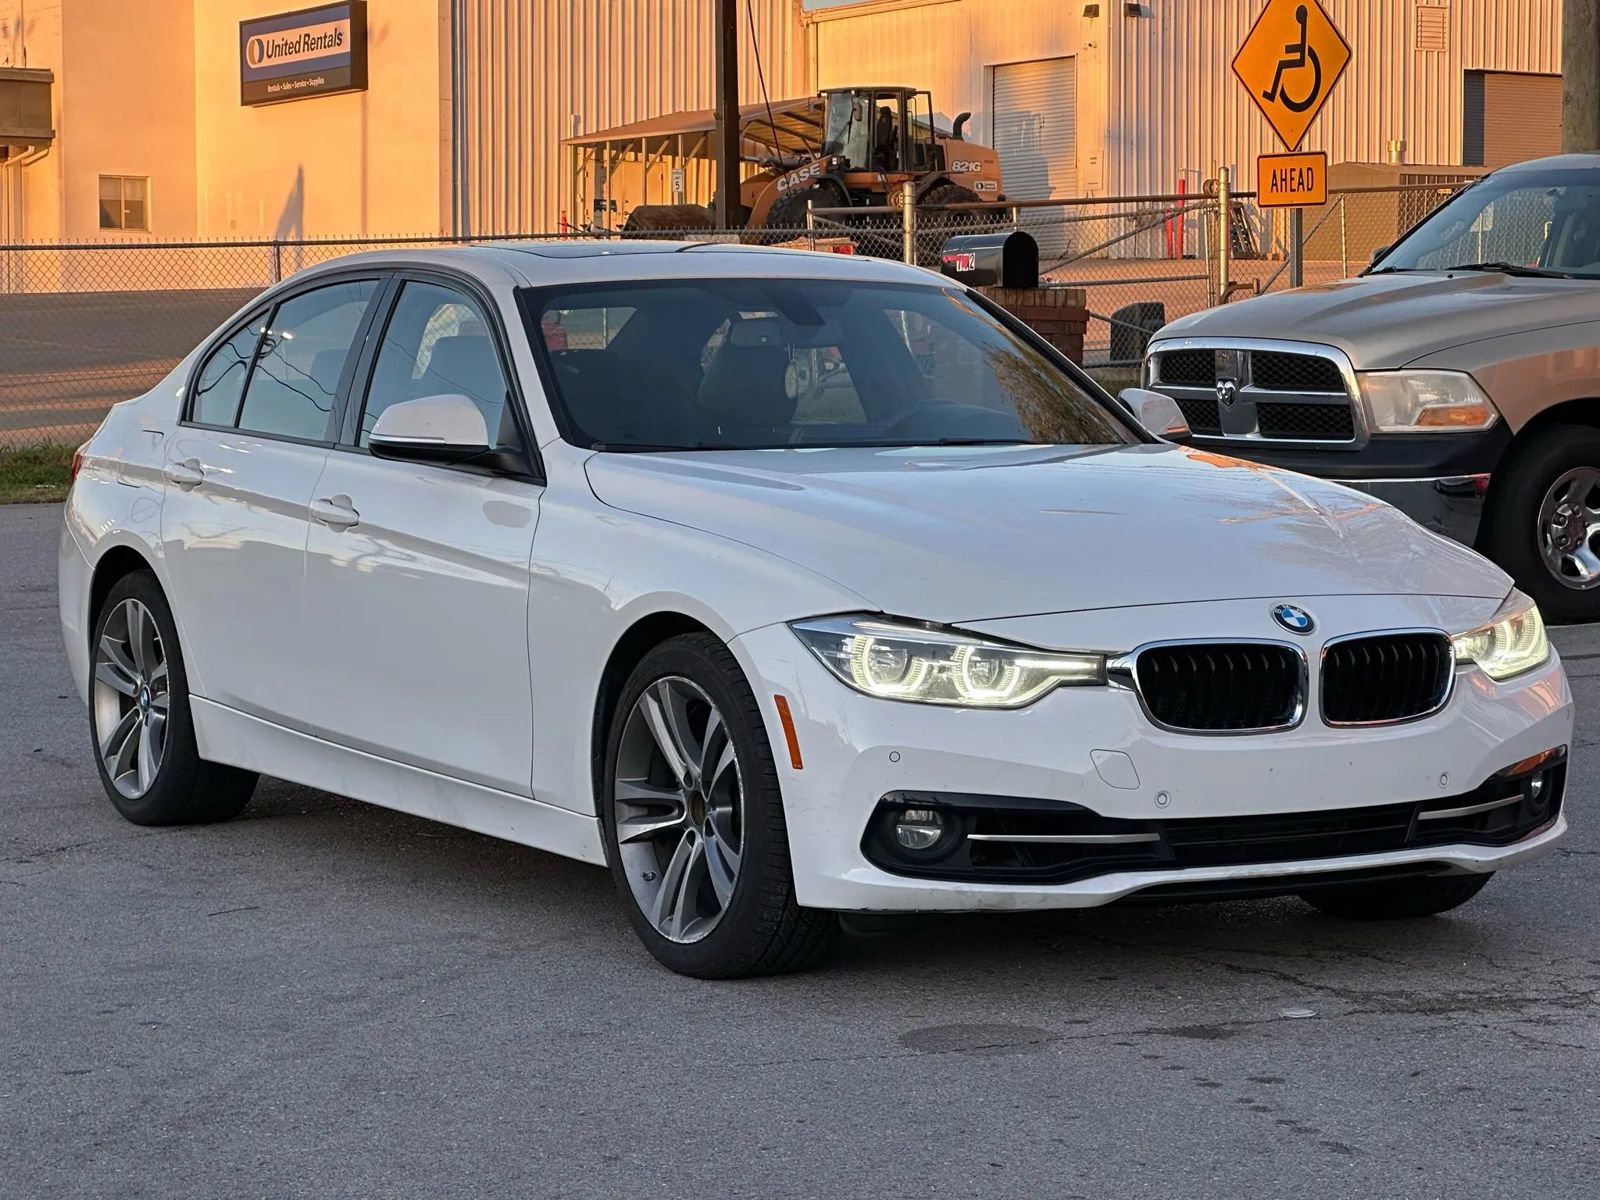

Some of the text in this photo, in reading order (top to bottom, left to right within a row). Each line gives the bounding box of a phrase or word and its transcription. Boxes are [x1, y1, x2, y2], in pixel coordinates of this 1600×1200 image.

[266, 27, 343, 59] United Rentals
[776, 162, 820, 192] CASE
[951, 160, 982, 172] 821G
[1270, 166, 1314, 193] AHEAD
[675, 180, 680, 190] 5
